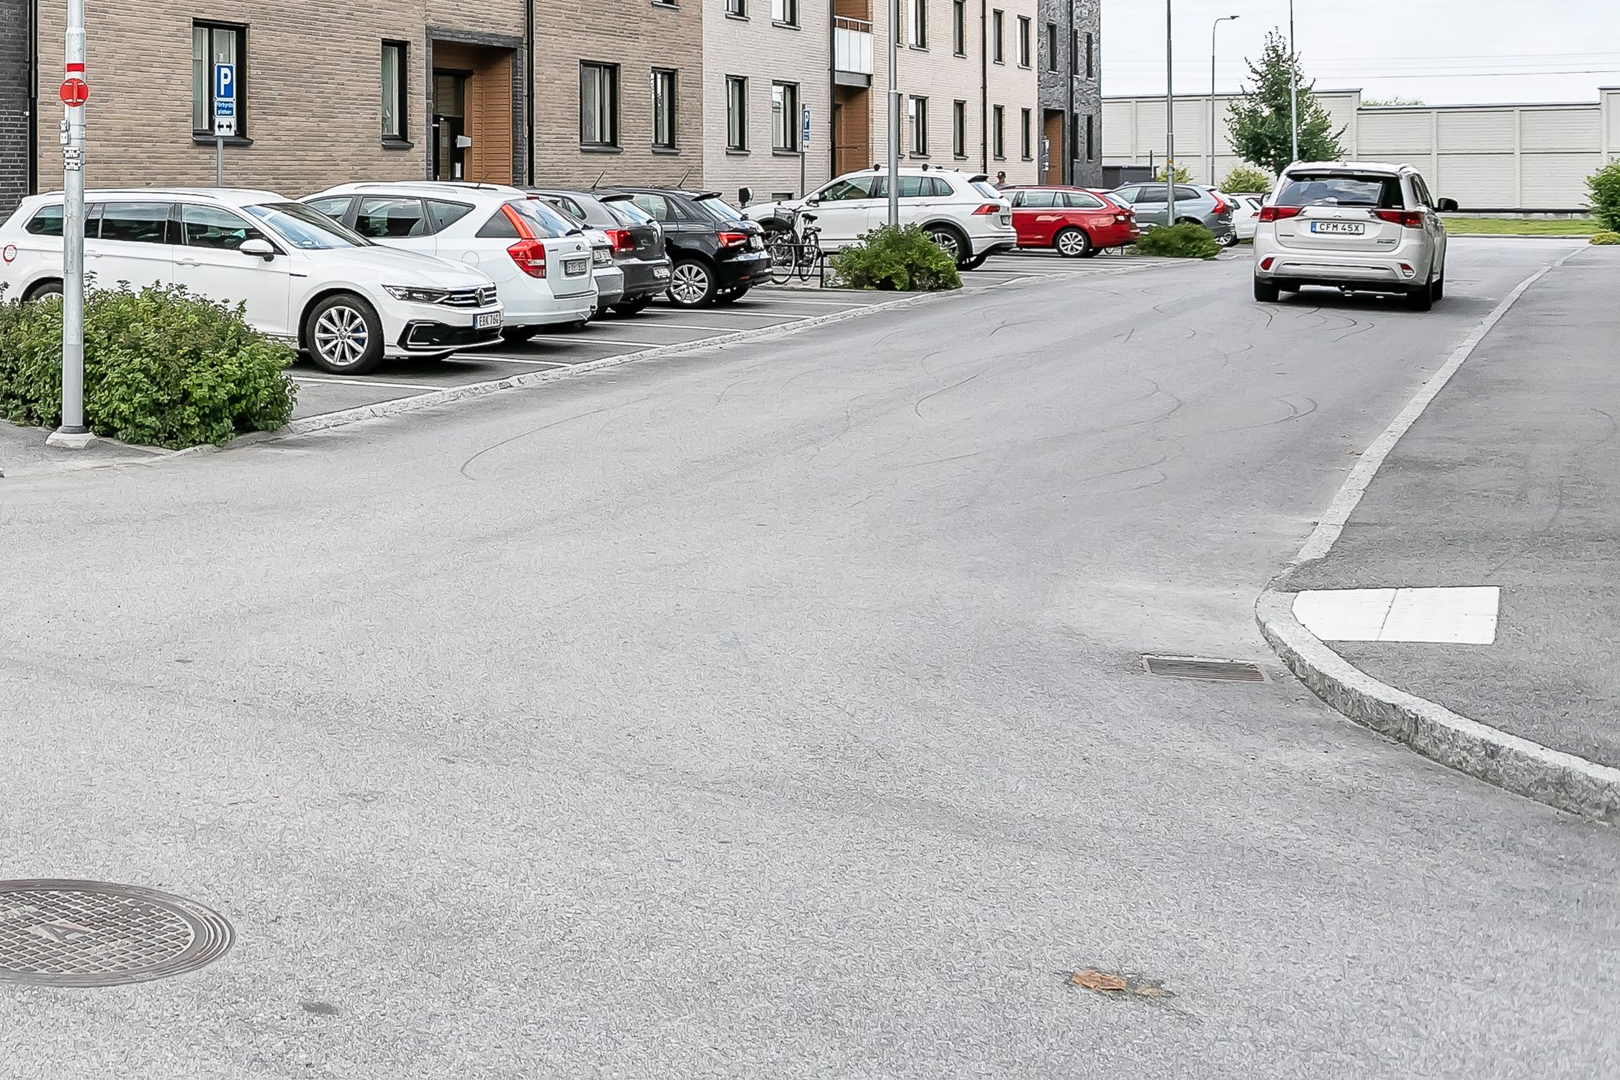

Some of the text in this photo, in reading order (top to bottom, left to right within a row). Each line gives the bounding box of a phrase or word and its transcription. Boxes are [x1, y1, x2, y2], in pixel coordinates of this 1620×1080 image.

[220, 67, 232, 96] P
[804, 111, 810, 129] P
[1319, 223, 1360, 232] CFM 45X
[479, 315, 490, 327] EBK
